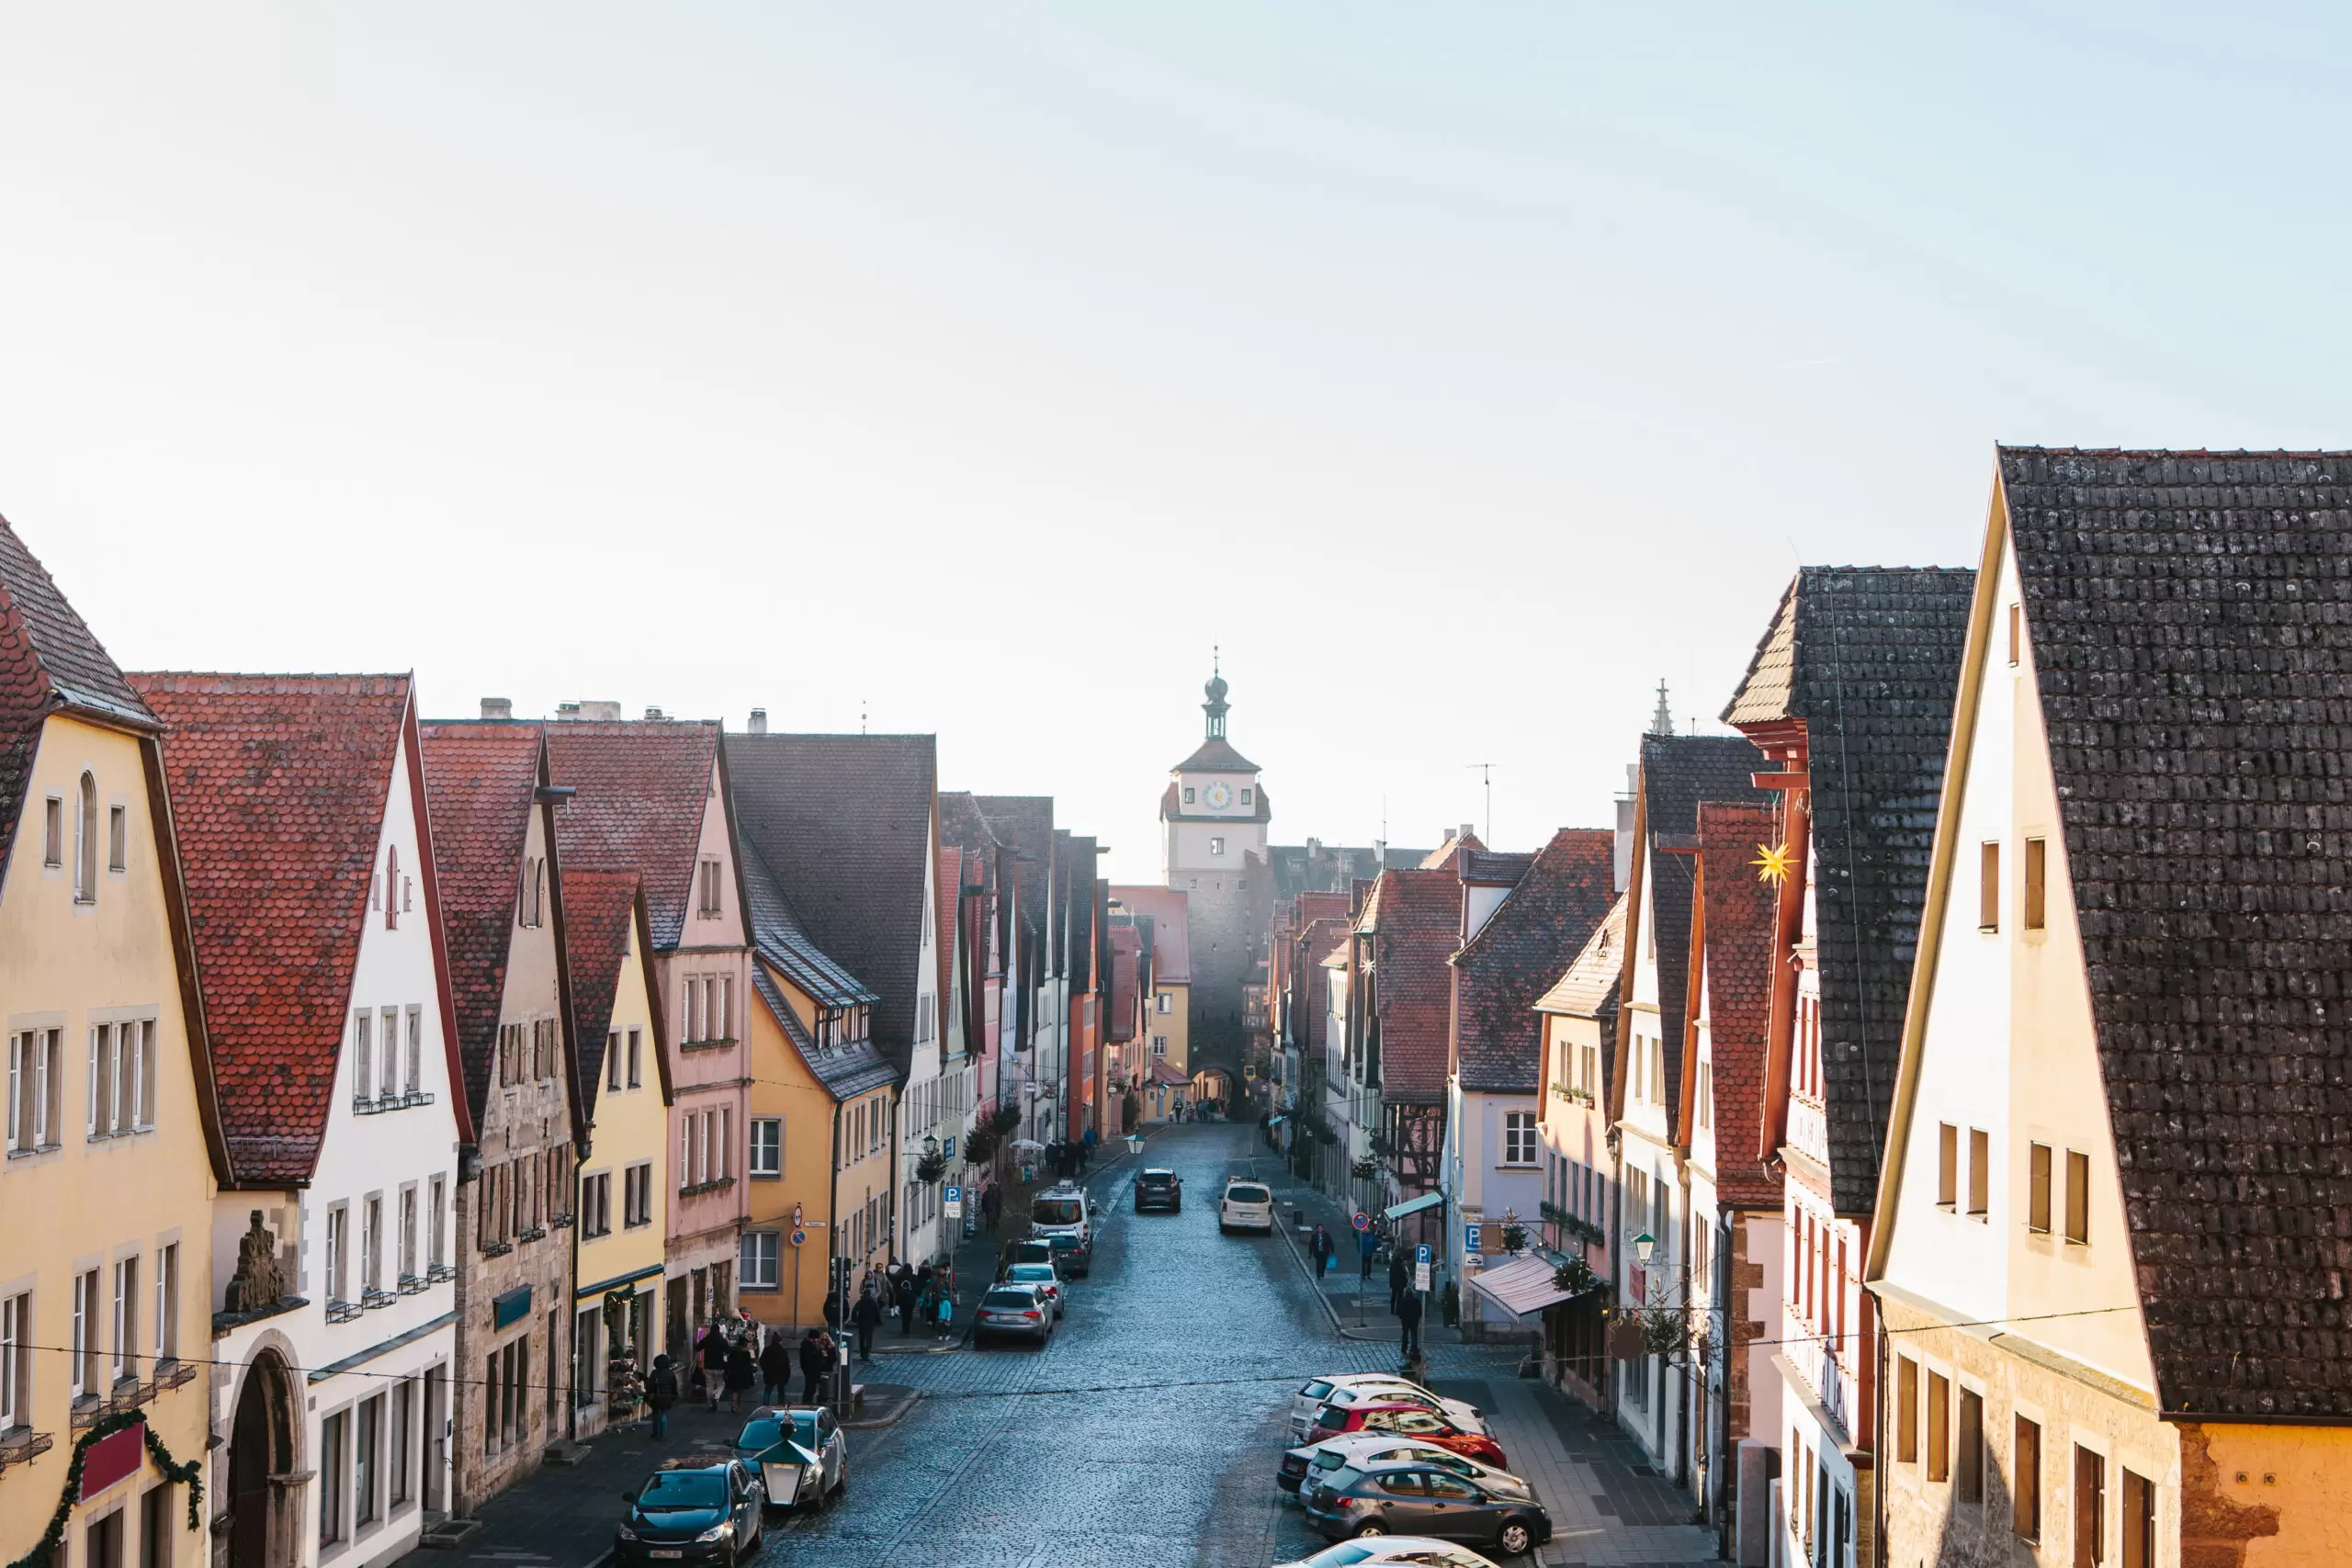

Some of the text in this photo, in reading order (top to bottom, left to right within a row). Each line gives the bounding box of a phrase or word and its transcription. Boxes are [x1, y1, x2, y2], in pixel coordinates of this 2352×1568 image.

[948, 1189, 957, 1201] P
[1469, 1228, 1480, 1246] P
[1419, 1247, 1428, 1262] P
